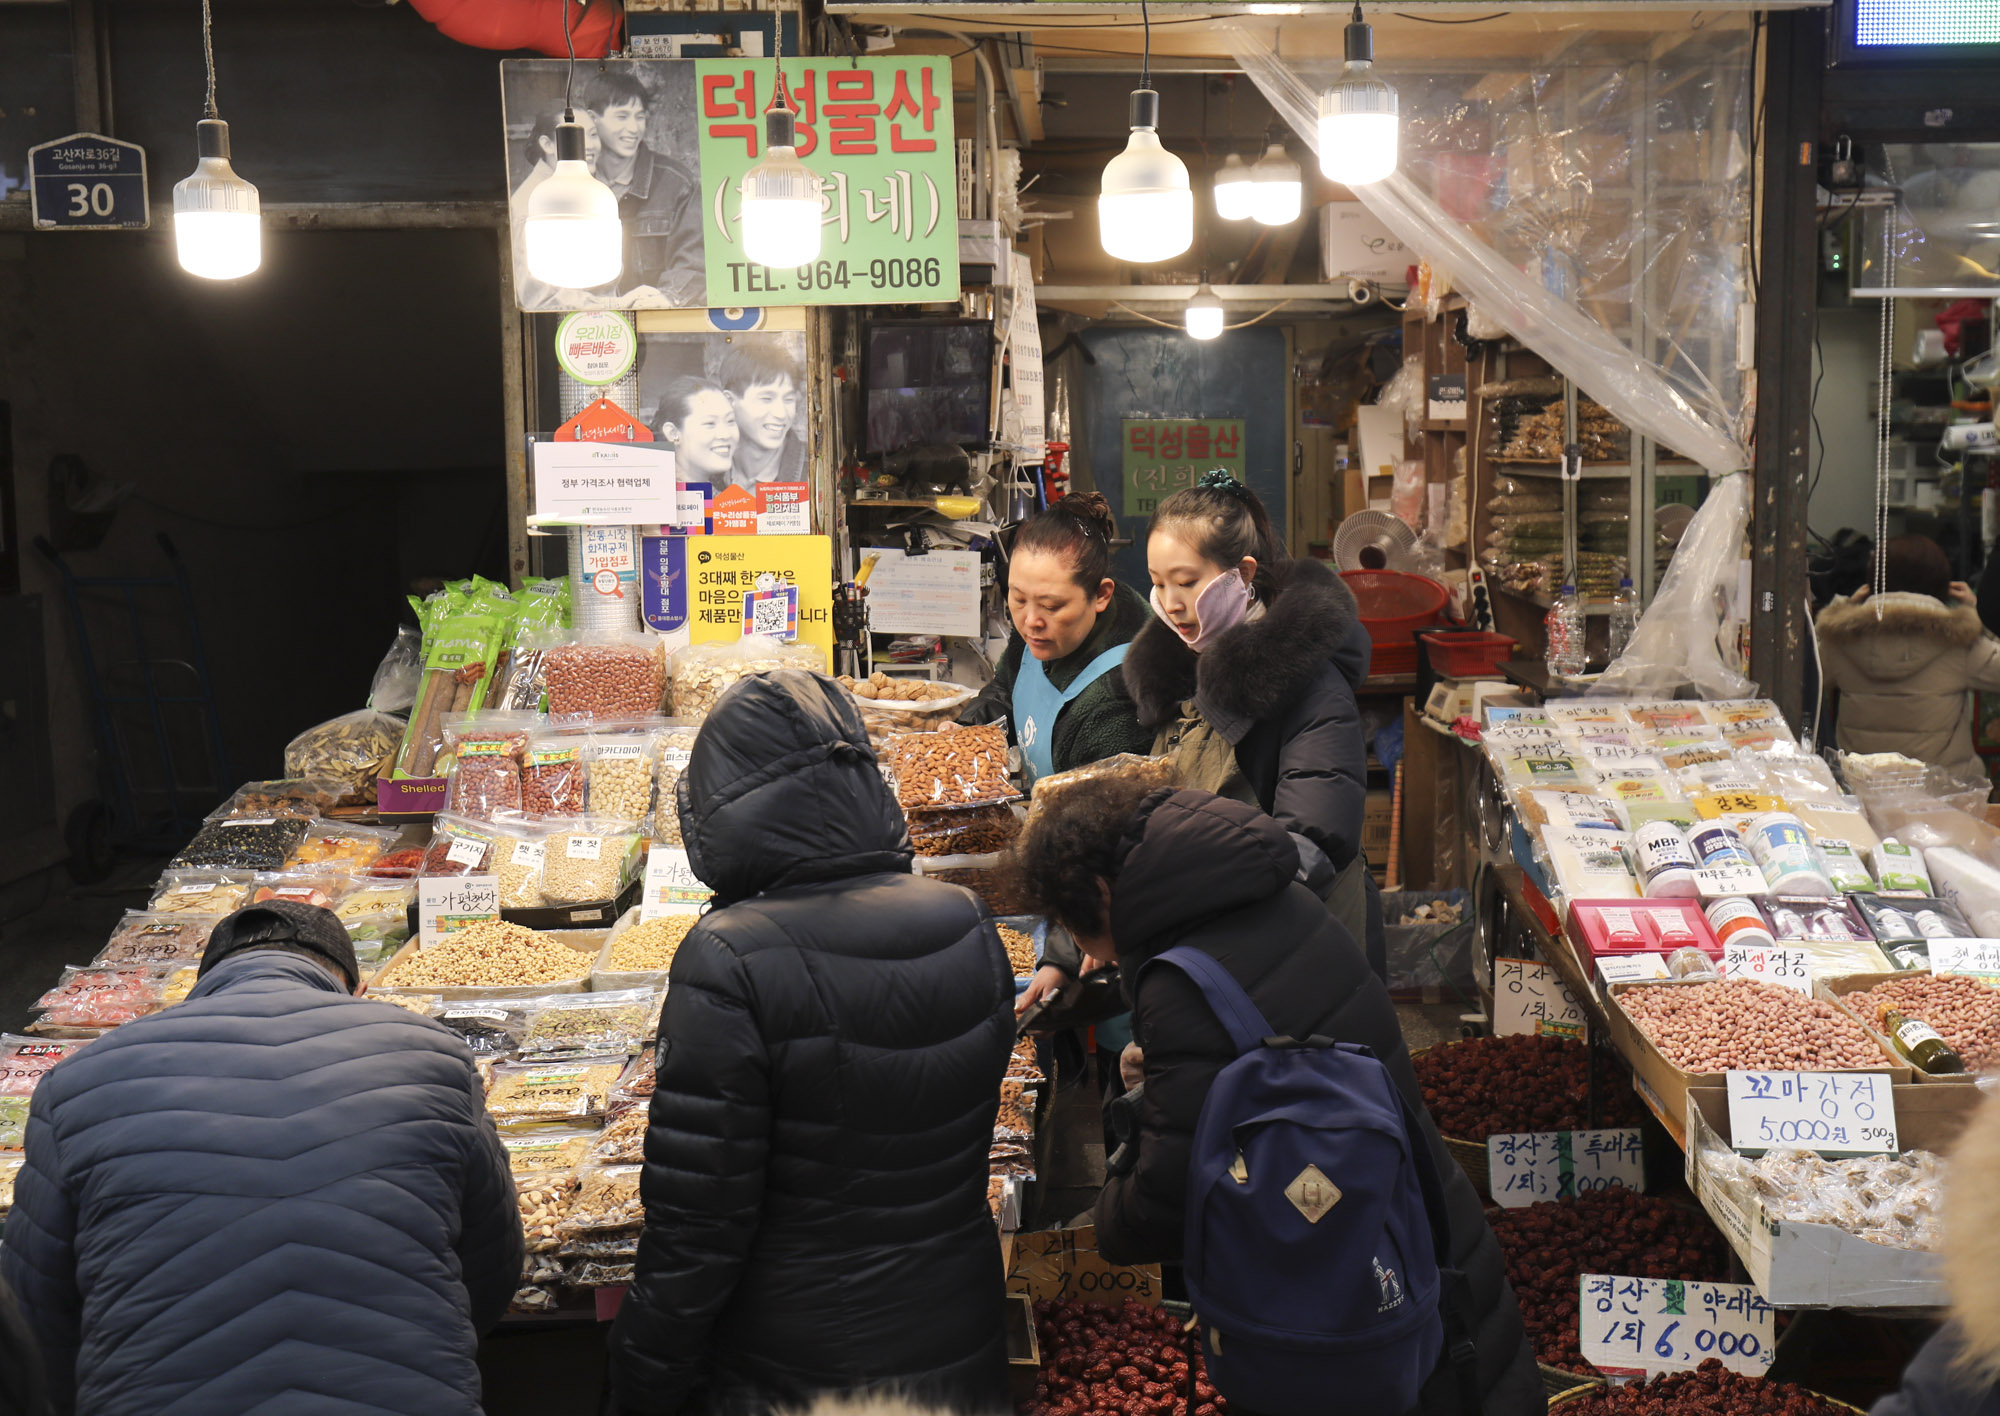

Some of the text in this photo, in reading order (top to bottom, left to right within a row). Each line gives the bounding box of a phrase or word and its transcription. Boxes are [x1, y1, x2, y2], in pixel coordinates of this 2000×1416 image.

[703, 67, 940, 158] 덕성물산
[52, 148, 120, 162] 고산자로36길
[67, 183, 114, 217] 30
[714, 170, 939, 243] (희네)
[727, 258, 941, 292] TEL. 964-9086
[575, 324, 623, 340] 우리시장
[569, 341, 616, 359] 빠른배송
[1130, 425, 1240, 459] 덕성물산
[562, 478, 651, 488] 정부 가격조사 협력업체
[1132, 464, 1237, 491] (진희)
[588, 542, 628, 554] 화재공제
[589, 555, 629, 568] 가입점포
[699, 571, 736, 585] 3대째
[699, 590, 743, 604] 마음으
[597, 746, 641, 755] 마카다미아
[453, 840, 484, 855] 구기자
[1647, 837, 1680, 852] MBP
[20, 1045, 62, 1054] 오미자
[1741, 1073, 1874, 1121] 꼬마강정
